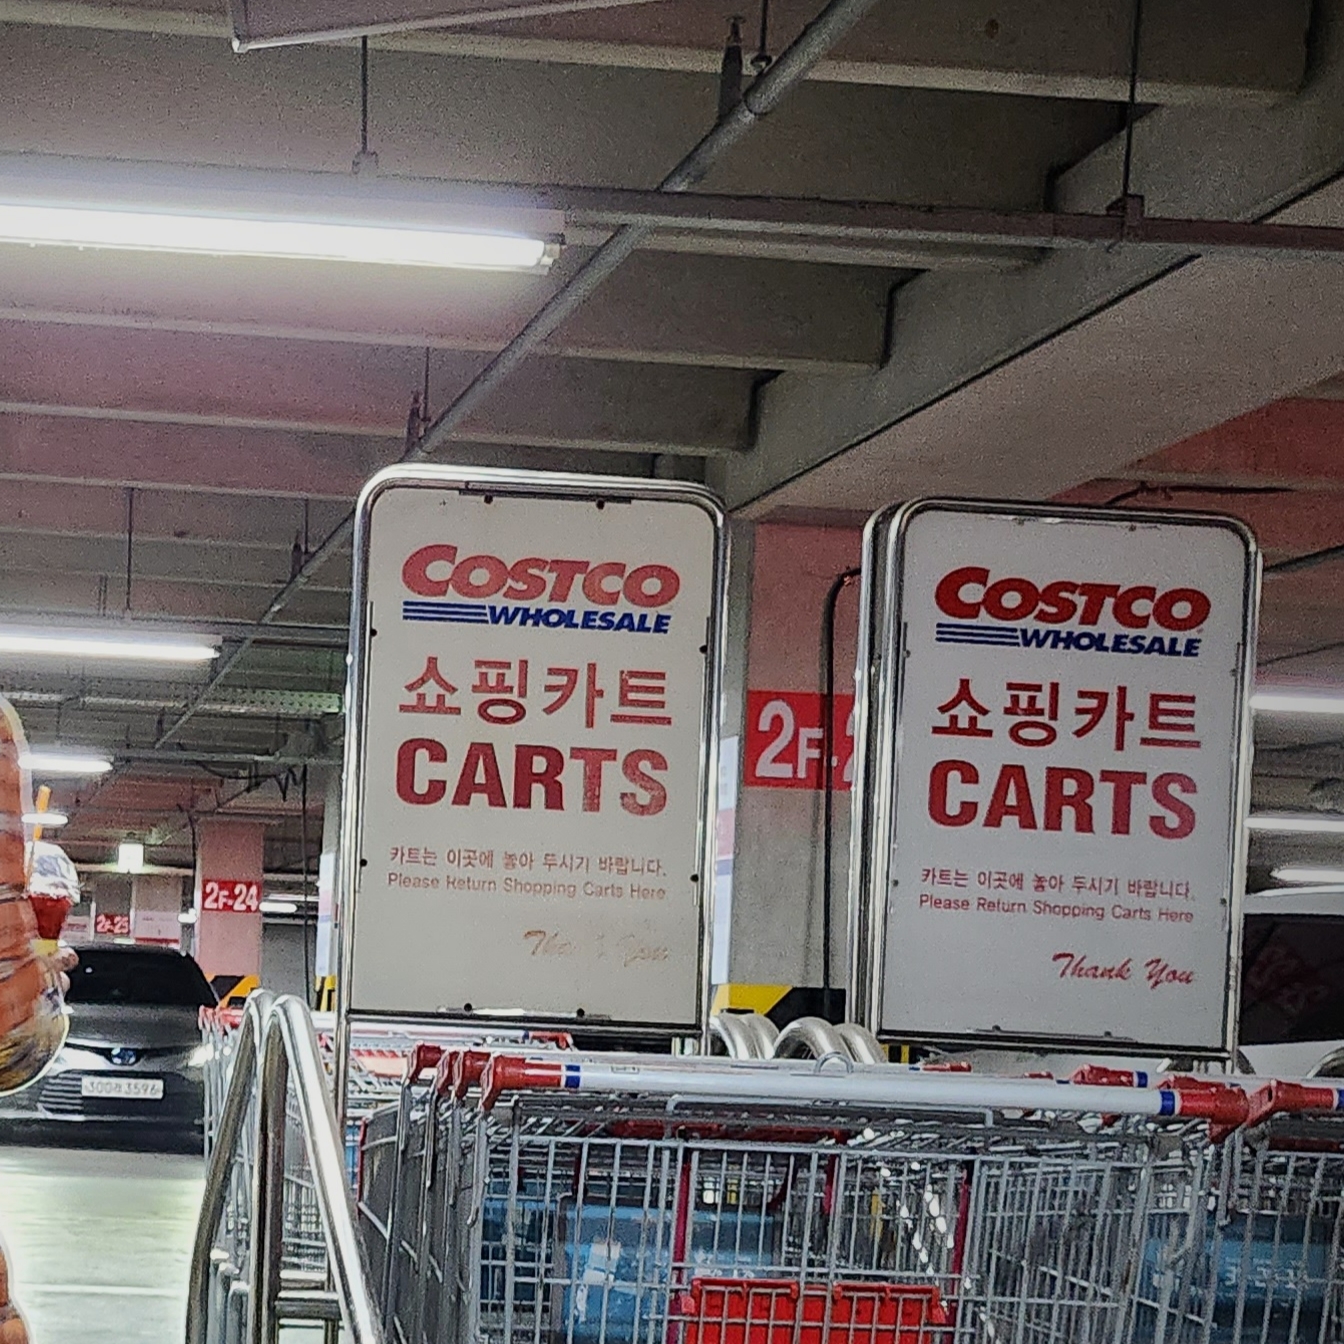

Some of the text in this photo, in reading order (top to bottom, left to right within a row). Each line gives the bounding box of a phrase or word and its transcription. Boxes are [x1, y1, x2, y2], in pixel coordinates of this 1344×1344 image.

[401, 544, 681, 608] COSTCO
[935, 566, 1212, 631] COSTCO
[488, 605, 672, 634] WHOLESALE
[1019, 628, 1202, 657] WHOLESALE
[399, 656, 672, 729] 쇼핑카트
[931, 678, 1202, 751] 쇼핑카트
[395, 737, 669, 816] CARTS
[928, 759, 1198, 839] CARTS
[390, 846, 437, 866] 카트는
[447, 848, 494, 869] 이곳에
[543, 852, 590, 873] 두시기
[599, 855, 666, 877] 바랍니다.
[204, 881, 259, 911] 2F-24
[388, 872, 666, 900] Please Return Shopping Carts Here
[921, 867, 969, 888] 카트는
[977, 870, 1024, 890] 이곳에
[1033, 873, 1064, 893] 놓아
[1072, 875, 1119, 896] 두시기
[919, 894, 1194, 924] Please Return Shopping Carts Here
[1052, 952, 1195, 990] Thank You
